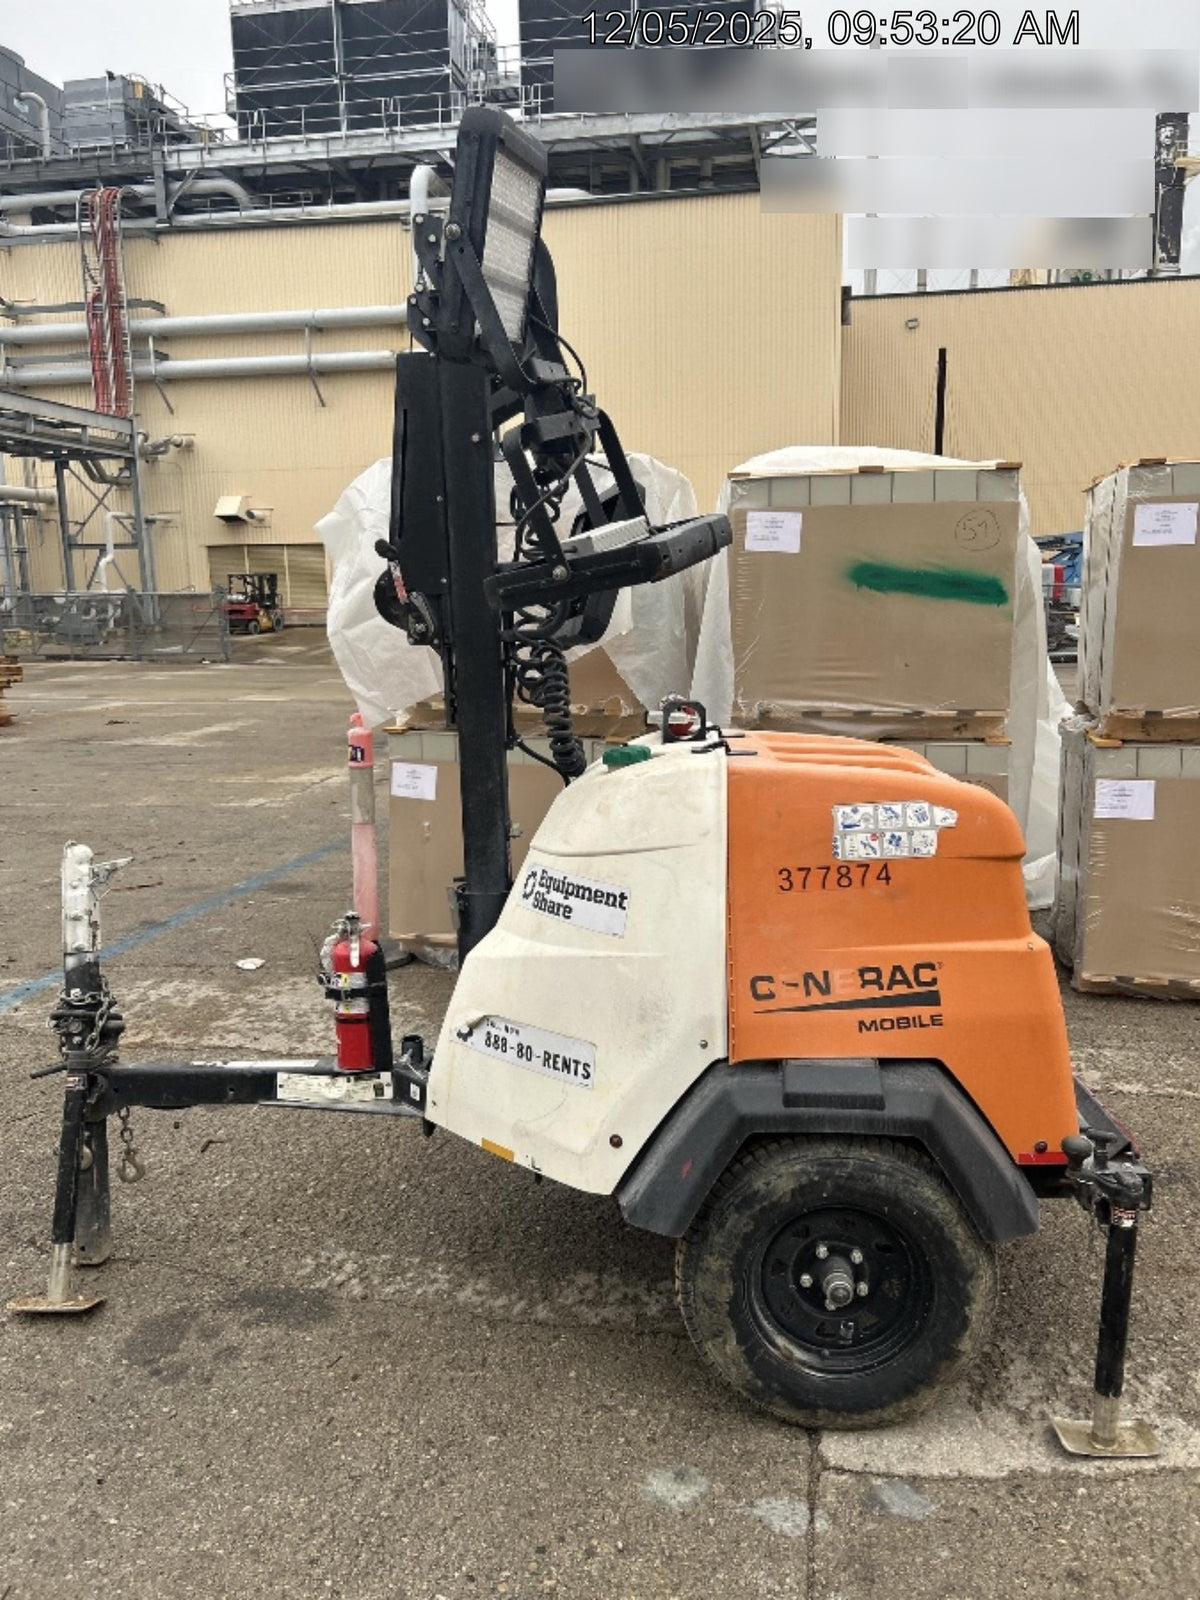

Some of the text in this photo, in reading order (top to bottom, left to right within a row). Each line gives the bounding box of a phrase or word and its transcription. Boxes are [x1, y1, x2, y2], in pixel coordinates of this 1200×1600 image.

[538, 868, 629, 911] Equipment
[778, 862, 892, 892] 377874
[532, 890, 574, 920] Share
[750, 961, 939, 1002] GNRAC
[858, 1013, 944, 1034] MOBILE
